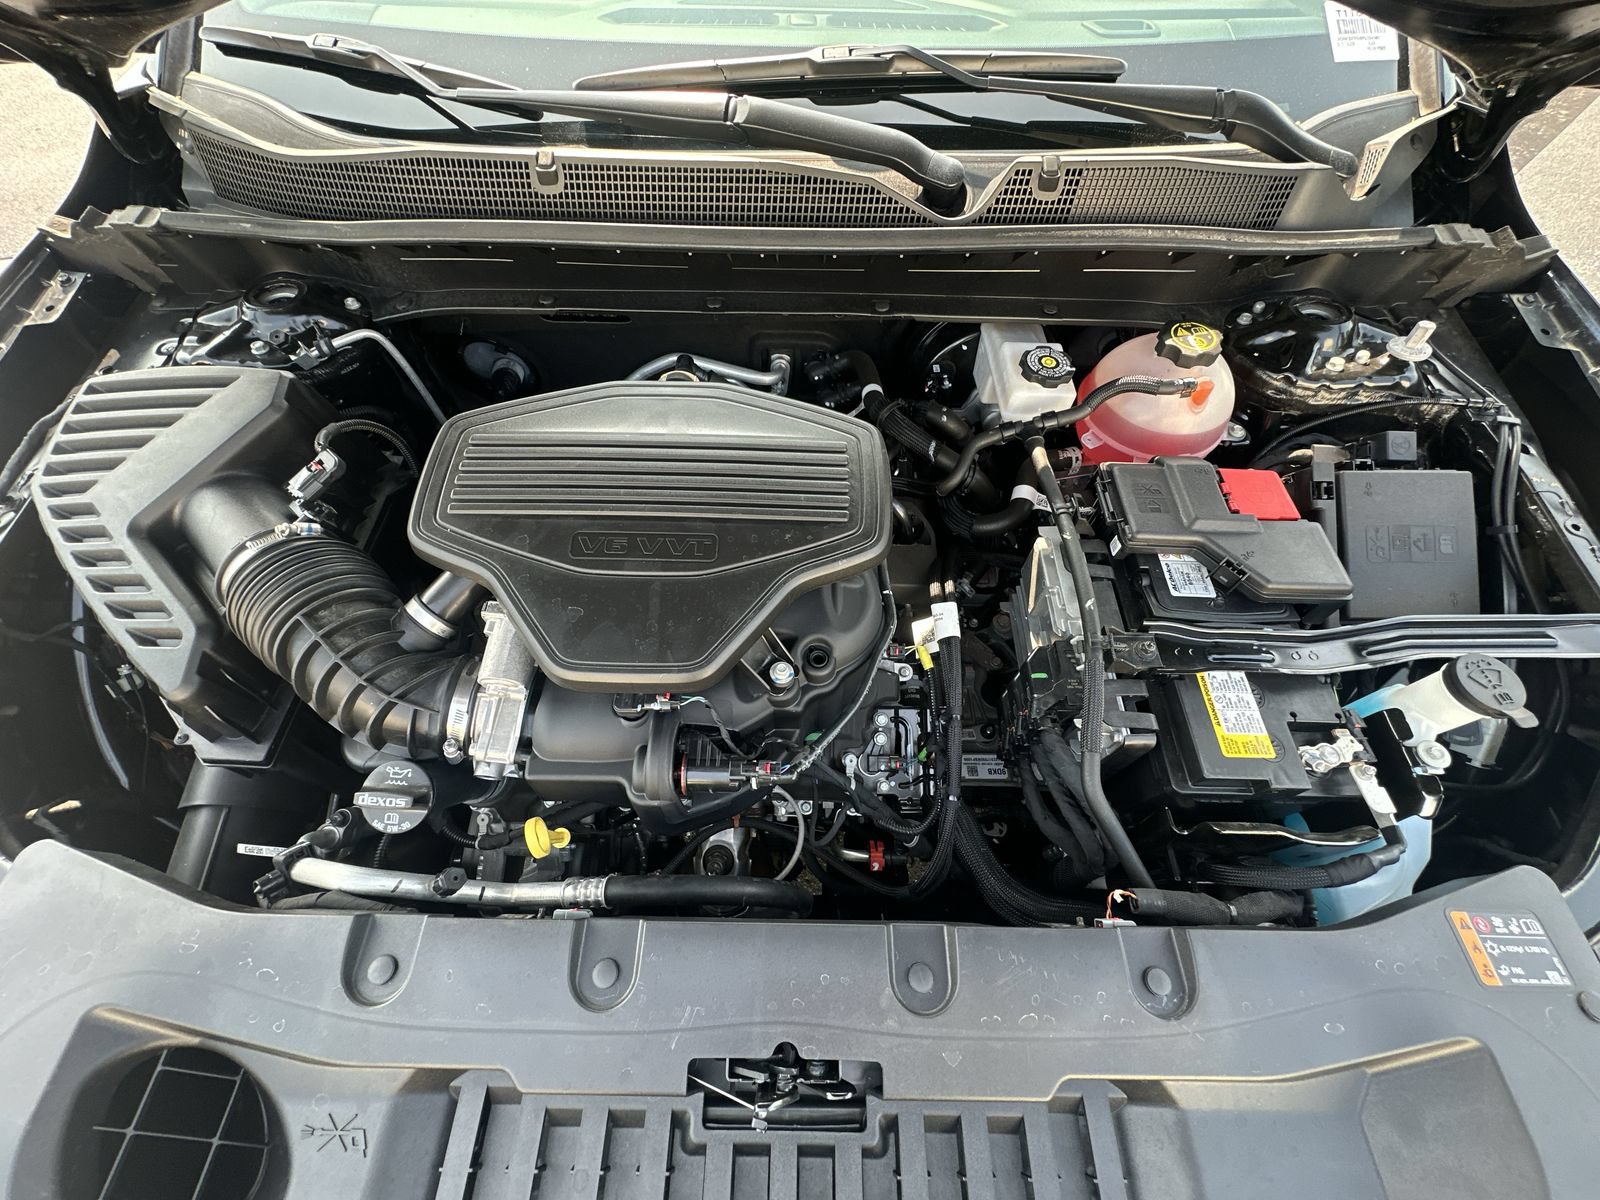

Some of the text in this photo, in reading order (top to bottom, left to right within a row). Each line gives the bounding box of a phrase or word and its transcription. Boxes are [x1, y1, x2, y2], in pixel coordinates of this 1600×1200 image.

[578, 536, 713, 556] V6 VVT
[357, 793, 409, 808] dexos
[372, 819, 411, 833] SAE 5W-30
